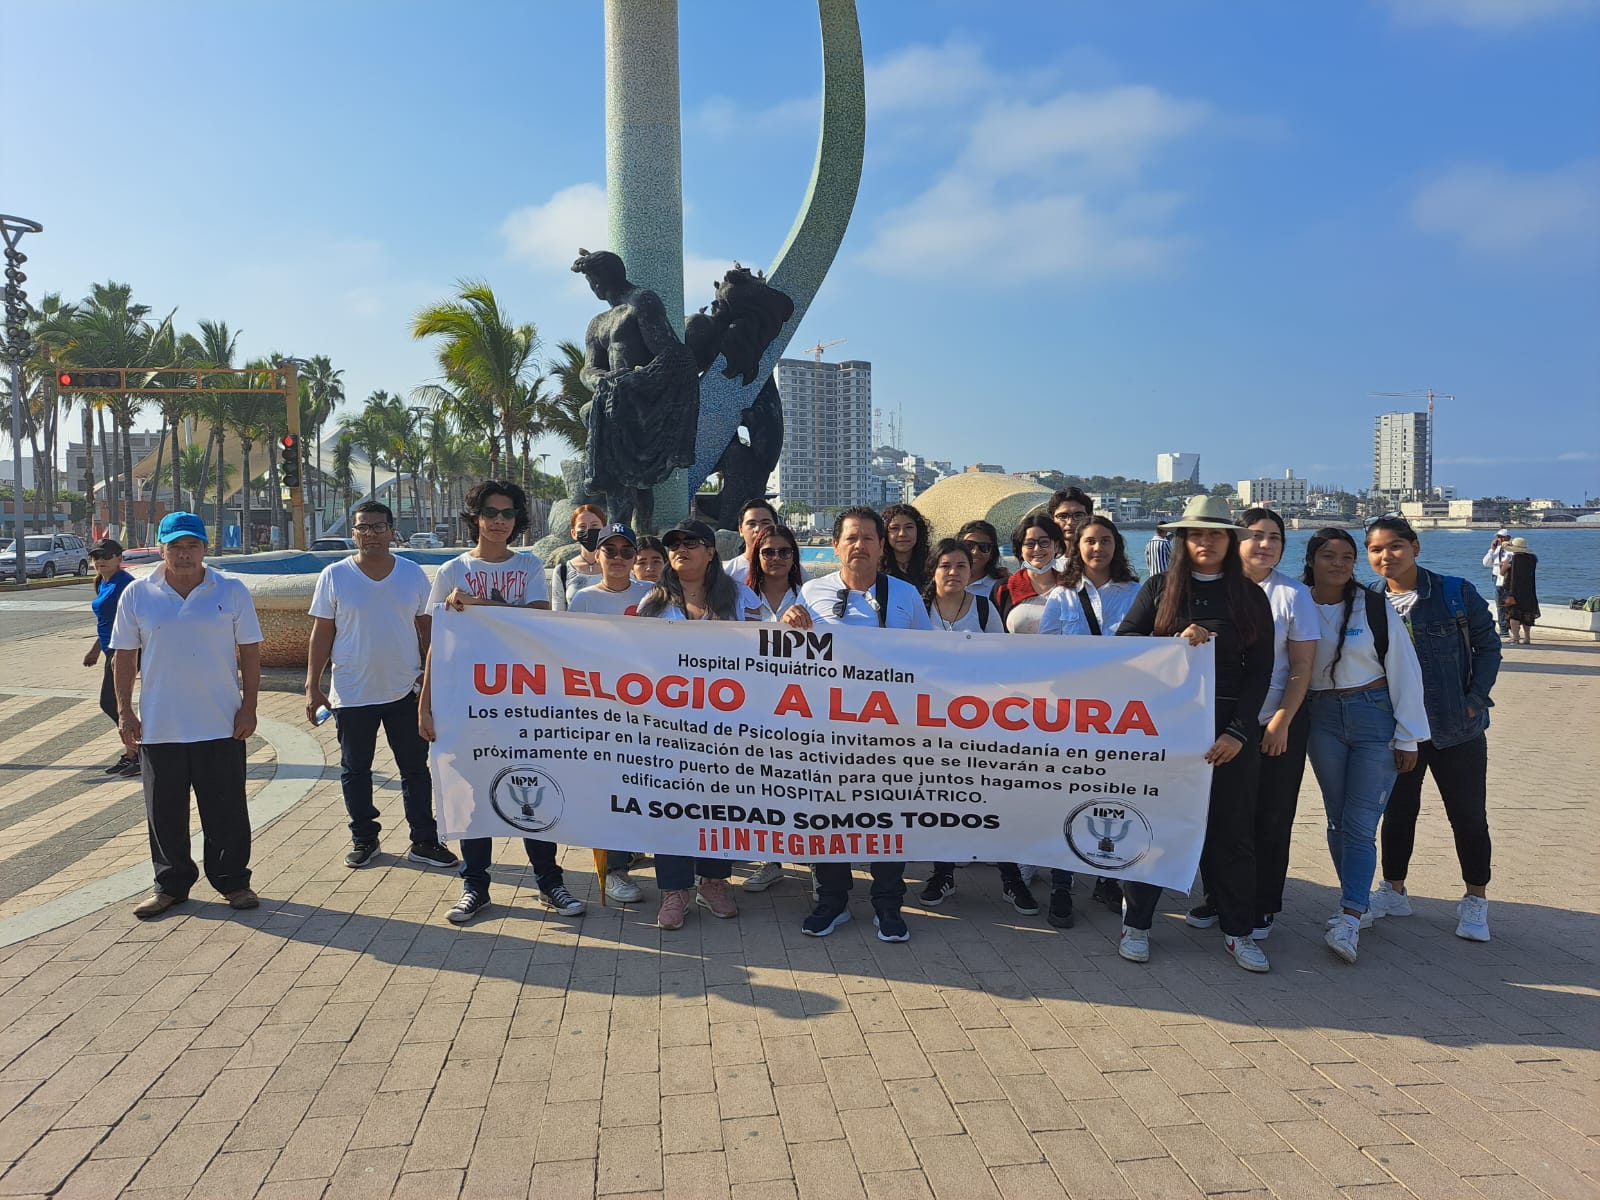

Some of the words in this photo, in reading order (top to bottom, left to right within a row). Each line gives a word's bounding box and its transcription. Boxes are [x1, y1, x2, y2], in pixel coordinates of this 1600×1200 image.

[465, 570, 488, 600] BAD
[759, 629, 833, 661] HPM
[679, 654, 739, 672] Hospital
[746, 658, 837, 678] Psiquiátrico
[843, 665, 914, 683] Mazatlan
[474, 664, 546, 695] UN
[562, 667, 745, 711] ELOGIO
[774, 684, 812, 718] A
[829, 688, 899, 725] LA
[917, 694, 1159, 736] LOCURA
[469, 705, 498, 718] Los
[505, 706, 598, 720] estudiantes
[604, 709, 621, 722] de
[627, 711, 639, 724] la
[643, 715, 707, 734] Facultad
[714, 722, 732, 736] de
[832, 731, 916, 746] invitamos
[922, 739, 931, 748] a
[939, 737, 952, 749] la
[960, 740, 1059, 757] ciudadanía
[1066, 748, 1087, 758] en
[1095, 749, 1165, 762] general
[519, 729, 527, 738] a
[534, 727, 610, 743] participar
[615, 733, 632, 743] en
[639, 732, 650, 745] la
[657, 737, 739, 755] realización
[745, 745, 764, 757] de
[770, 747, 793, 760] las
[799, 752, 896, 765] actividades
[903, 756, 934, 768] que
[941, 758, 960, 766] se
[968, 757, 1038, 772] llevarán
[1045, 765, 1054, 773] a
[1062, 765, 1106, 775] cabo
[473, 745, 587, 761] próximamente
[594, 751, 611, 761] en
[617, 753, 673, 768] nuestro
[680, 761, 729, 774] puerto
[736, 763, 754, 775] de
[761, 764, 831, 783] Mazatlán
[839, 774, 875, 786] para
[882, 774, 913, 785] que
[918, 772, 974, 786] juntos
[981, 775, 1062, 790] hagamos
[1069, 782, 1136, 795] posible
[1144, 785, 1158, 796] la
[511, 776, 538, 787] HPM
[622, 773, 704, 791] edificación
[711, 781, 729, 793] de
[736, 785, 755, 795] un
[762, 784, 846, 802] HOSPITAL
[852, 787, 986, 803] PSIQUIÁTRICO.
[611, 795, 642, 815] LA
[649, 801, 785, 825] SOCIEDAD
[793, 812, 893, 830] SOMOS
[900, 812, 1000, 829] TODOS
[1093, 808, 1125, 821] HPM
[700, 828, 902, 855] ¡¡INTEGRATE!!
